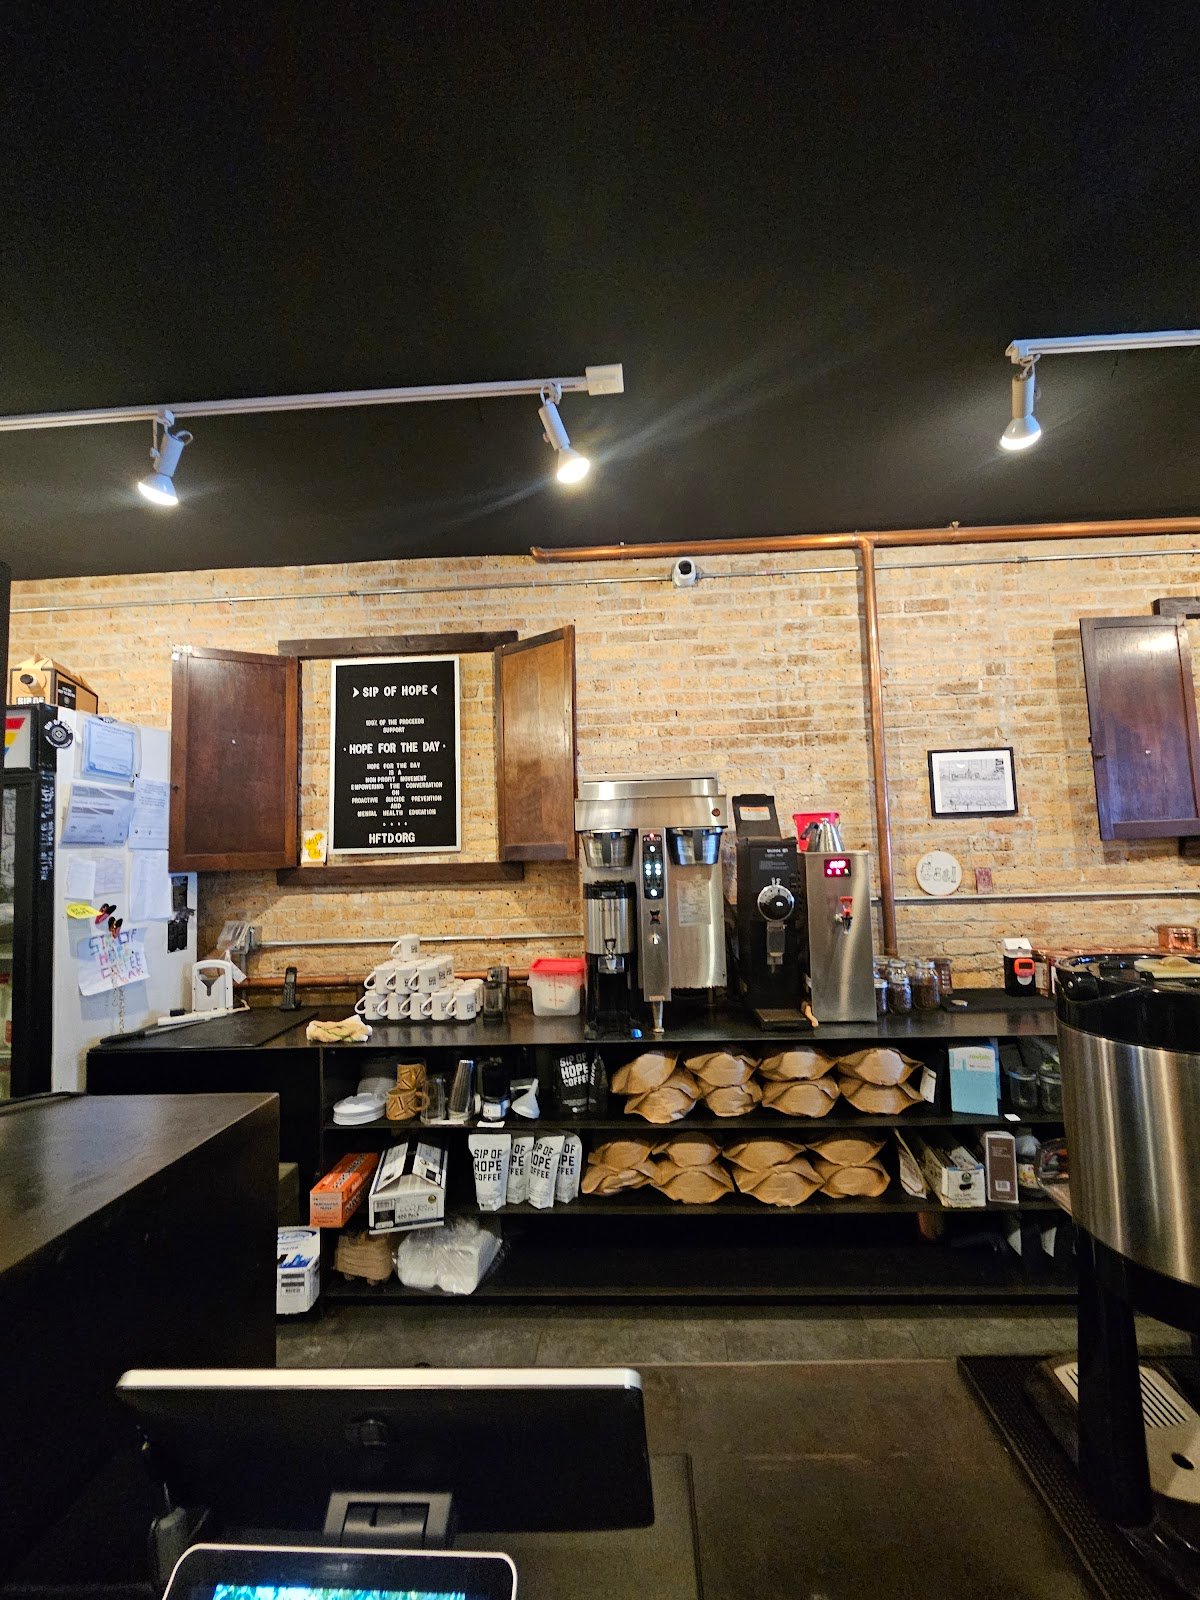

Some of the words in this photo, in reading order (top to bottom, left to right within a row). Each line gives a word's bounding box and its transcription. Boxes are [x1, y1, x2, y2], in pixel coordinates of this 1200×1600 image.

[362, 686, 380, 698] SIP
[383, 685, 397, 697] OF
[401, 684, 429, 697] HOPE
[388, 718, 398, 726] THE
[399, 717, 425, 726] PROCEEDS
[382, 726, 406, 734] SUPPORT
[349, 743, 374, 755] HOPE
[378, 742, 397, 754] FOR
[400, 742, 419, 753] THE
[422, 741, 440, 752] DAY
[383, 762, 394, 770] FOR
[365, 776, 377, 784] NON
[377, 775, 396, 783] PROFIT
[400, 775, 427, 783] MOVEMENT
[350, 783, 384, 791] EMPOWERING
[389, 782, 401, 790] THE
[405, 781, 443, 789] CONVERSATION
[411, 795, 442, 803] PREVENTION
[390, 802, 402, 810] AND
[357, 810, 378, 818] MENTAL
[382, 809, 404, 817] HEALTH
[408, 808, 437, 816] EDUCATION
[560, 1055, 575, 1068] SIP
[560, 1061, 589, 1080] HOPE
[514, 1144, 526, 1154] OF
[542, 1145, 554, 1157] OF
[564, 1143, 576, 1154] OF
[474, 1149, 489, 1159] SIP
[490, 1149, 503, 1159] OF
[474, 1160, 502, 1172] HOPE
[511, 1155, 525, 1167] PE
[561, 1155, 575, 1167] PE
[474, 1172, 502, 1182] COFFEE
[510, 1168, 524, 1176] FEE
